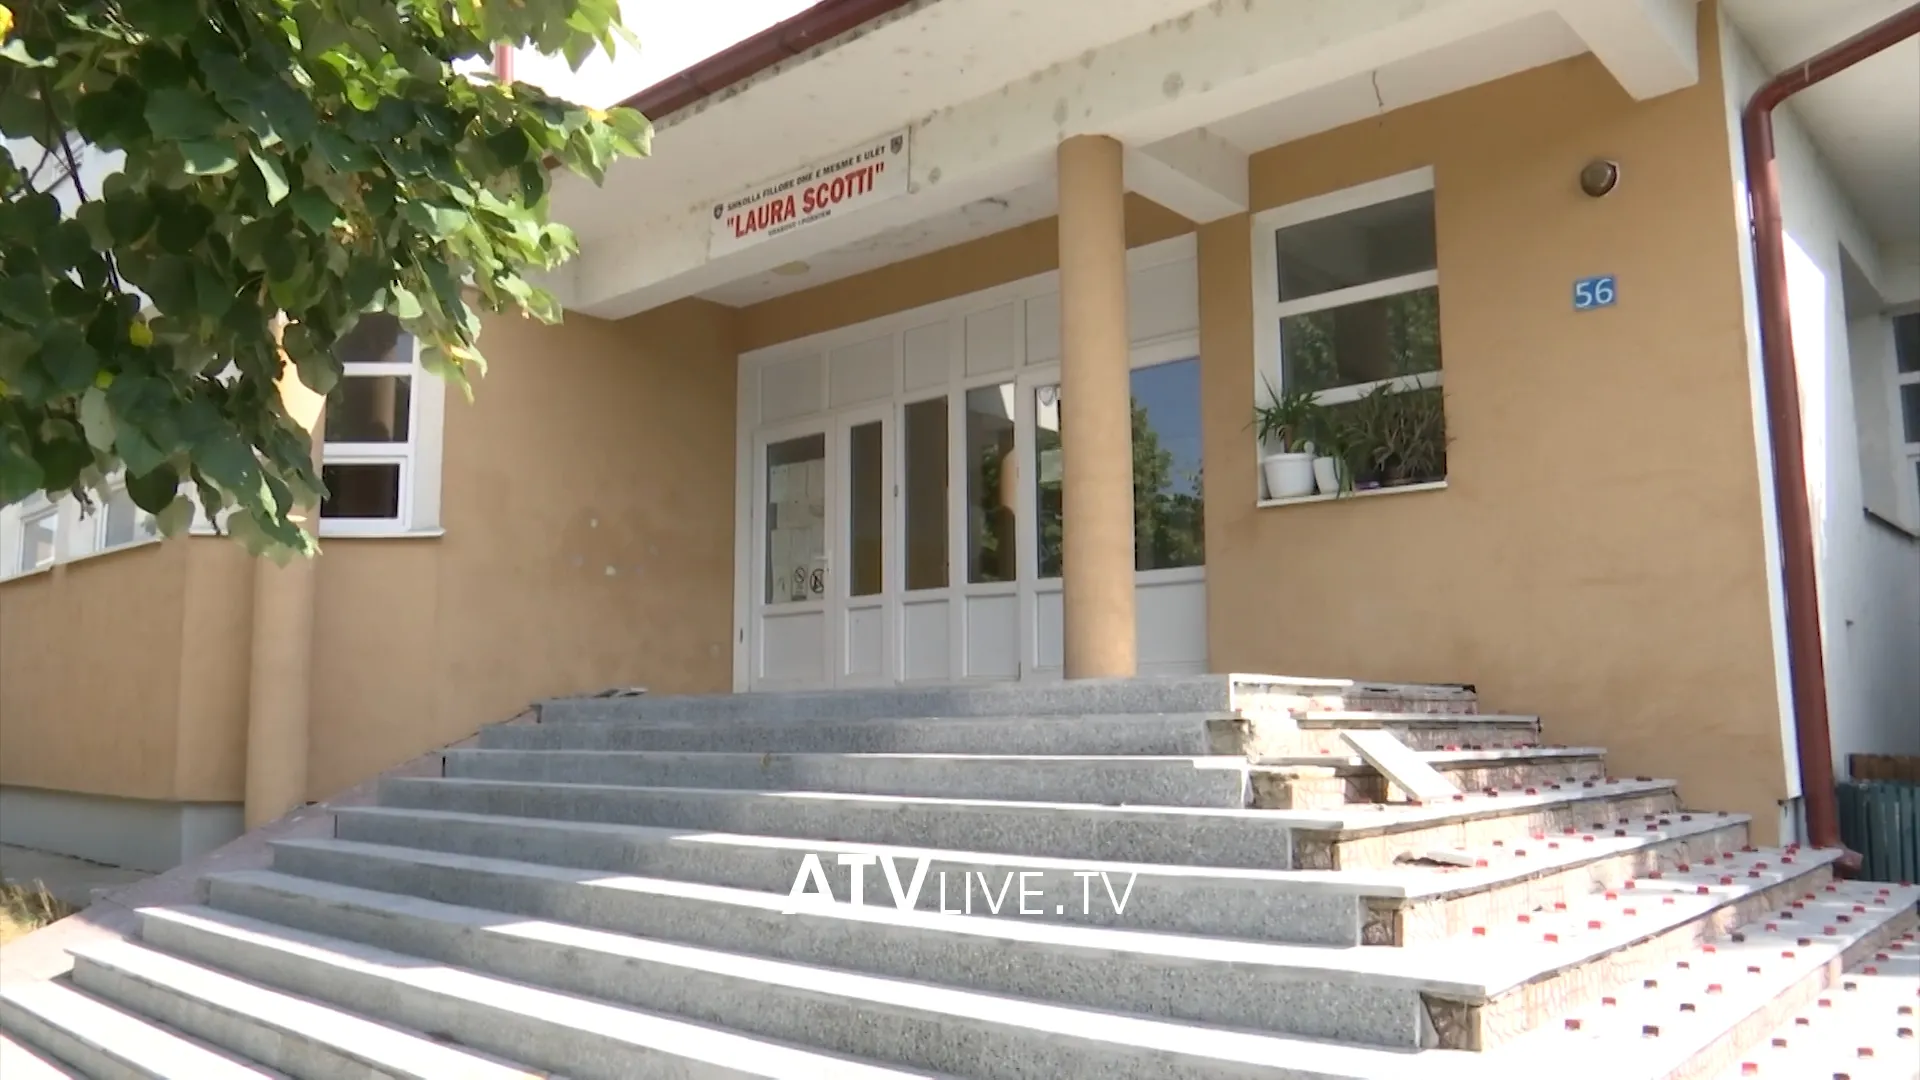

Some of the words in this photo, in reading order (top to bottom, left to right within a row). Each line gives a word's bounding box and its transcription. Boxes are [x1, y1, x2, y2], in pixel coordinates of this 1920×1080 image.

[823, 157, 854, 174] MESME
[856, 153, 862, 163] E
[727, 194, 796, 238] "LAURA
[802, 162, 884, 214] SCOTTI"
[1576, 278, 1613, 308] 56
